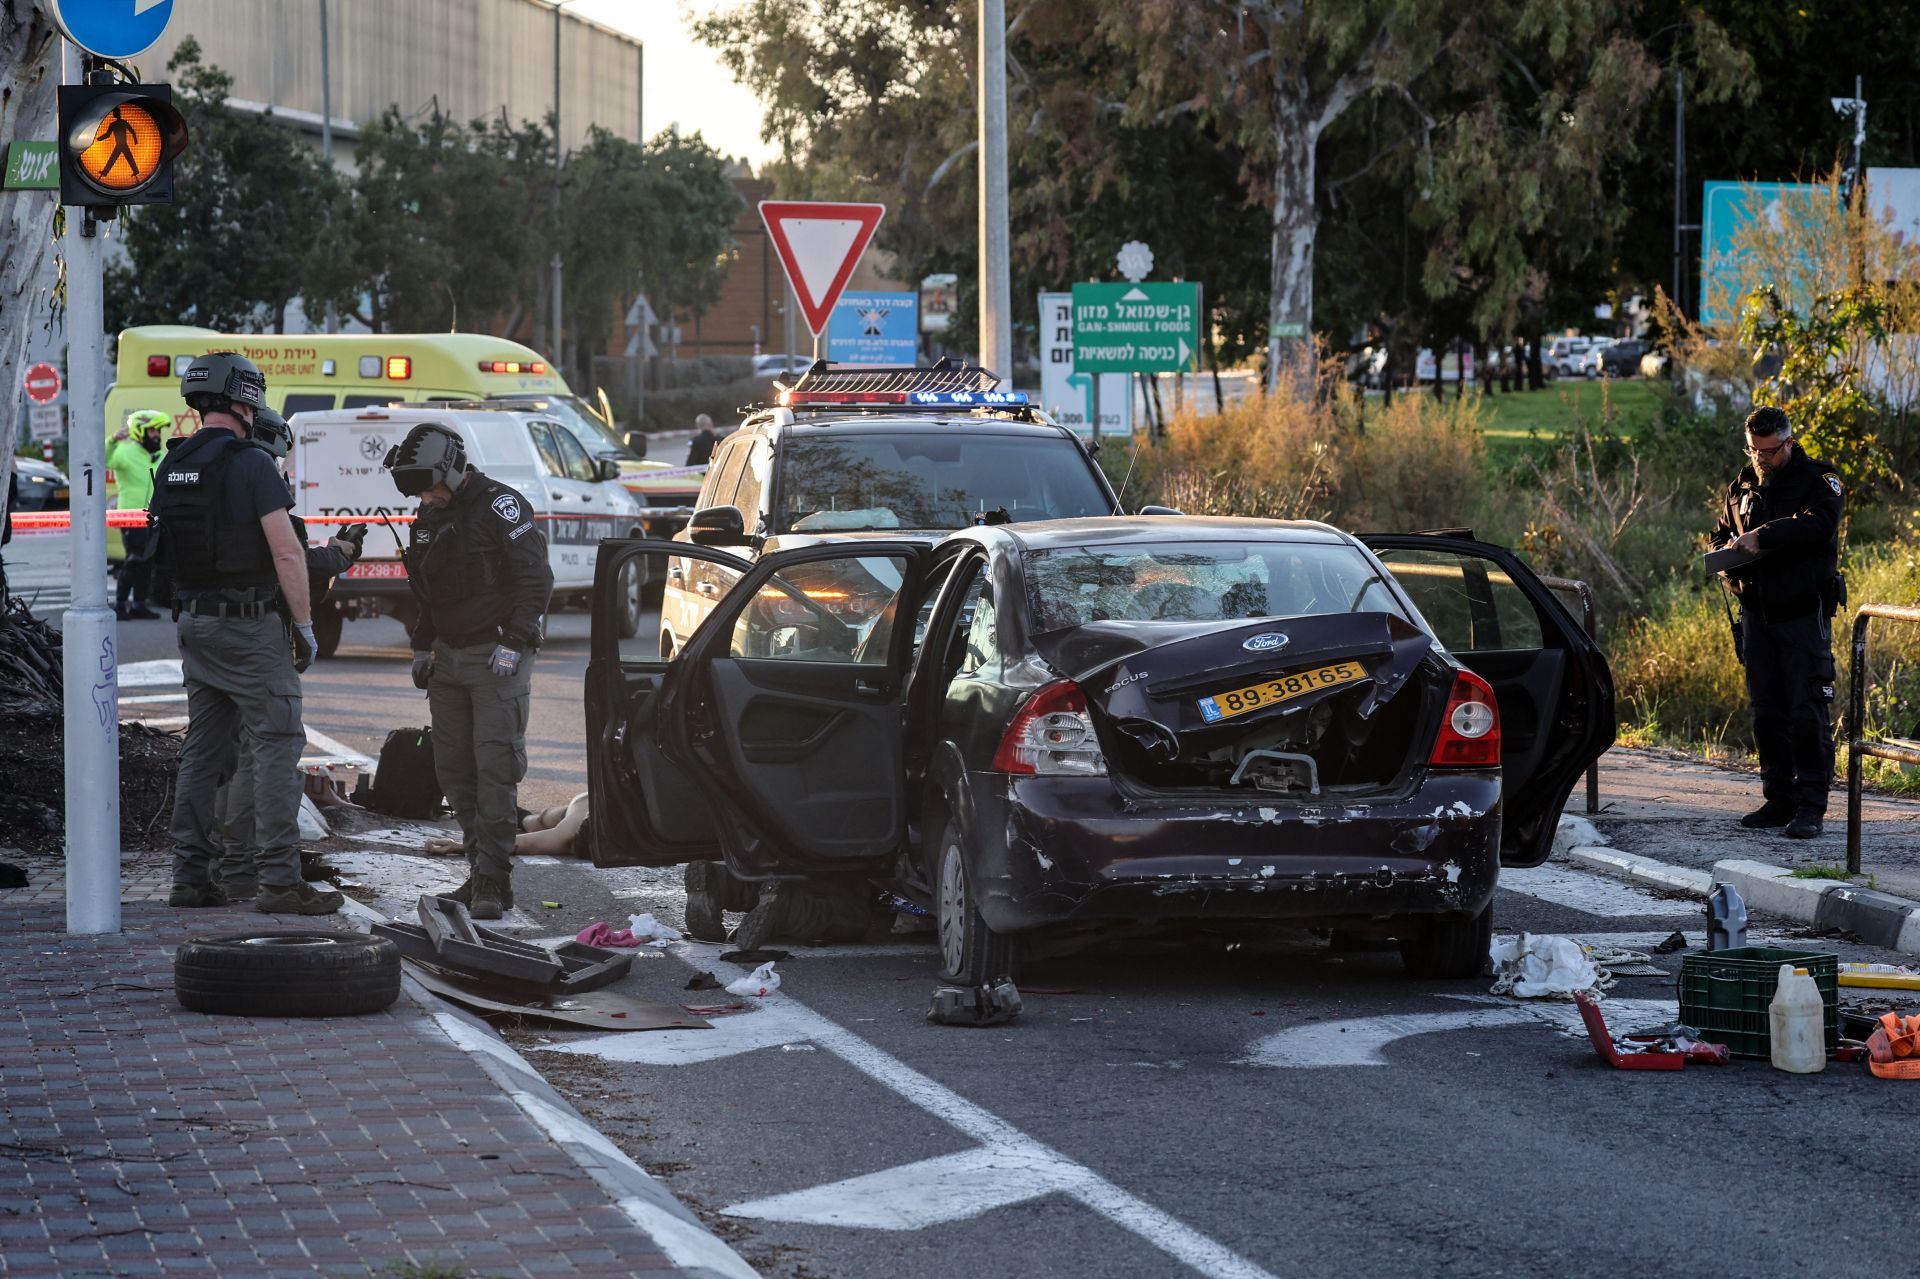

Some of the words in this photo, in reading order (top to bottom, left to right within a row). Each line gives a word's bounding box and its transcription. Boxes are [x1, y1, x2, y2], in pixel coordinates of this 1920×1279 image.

[1077, 305, 1109, 321] מזון
[1115, 302, 1191, 321] גן-שמואל
[1077, 321, 1151, 332] GAN-SHMUEL
[1154, 321, 1191, 332] FOODS
[242, 345, 279, 360] טיפול
[283, 347, 316, 360] ניידת
[1078, 342, 1135, 360] למשאיות
[1138, 346, 1175, 360] כניסה
[275, 364, 298, 375] CARE
[299, 364, 316, 375] UNIT
[168, 472, 184, 482] חבלה
[185, 472, 199, 483] קצין
[319, 507, 418, 527] TOYOT
[1254, 635, 1279, 648] Ford
[1104, 672, 1149, 694] FOCUS
